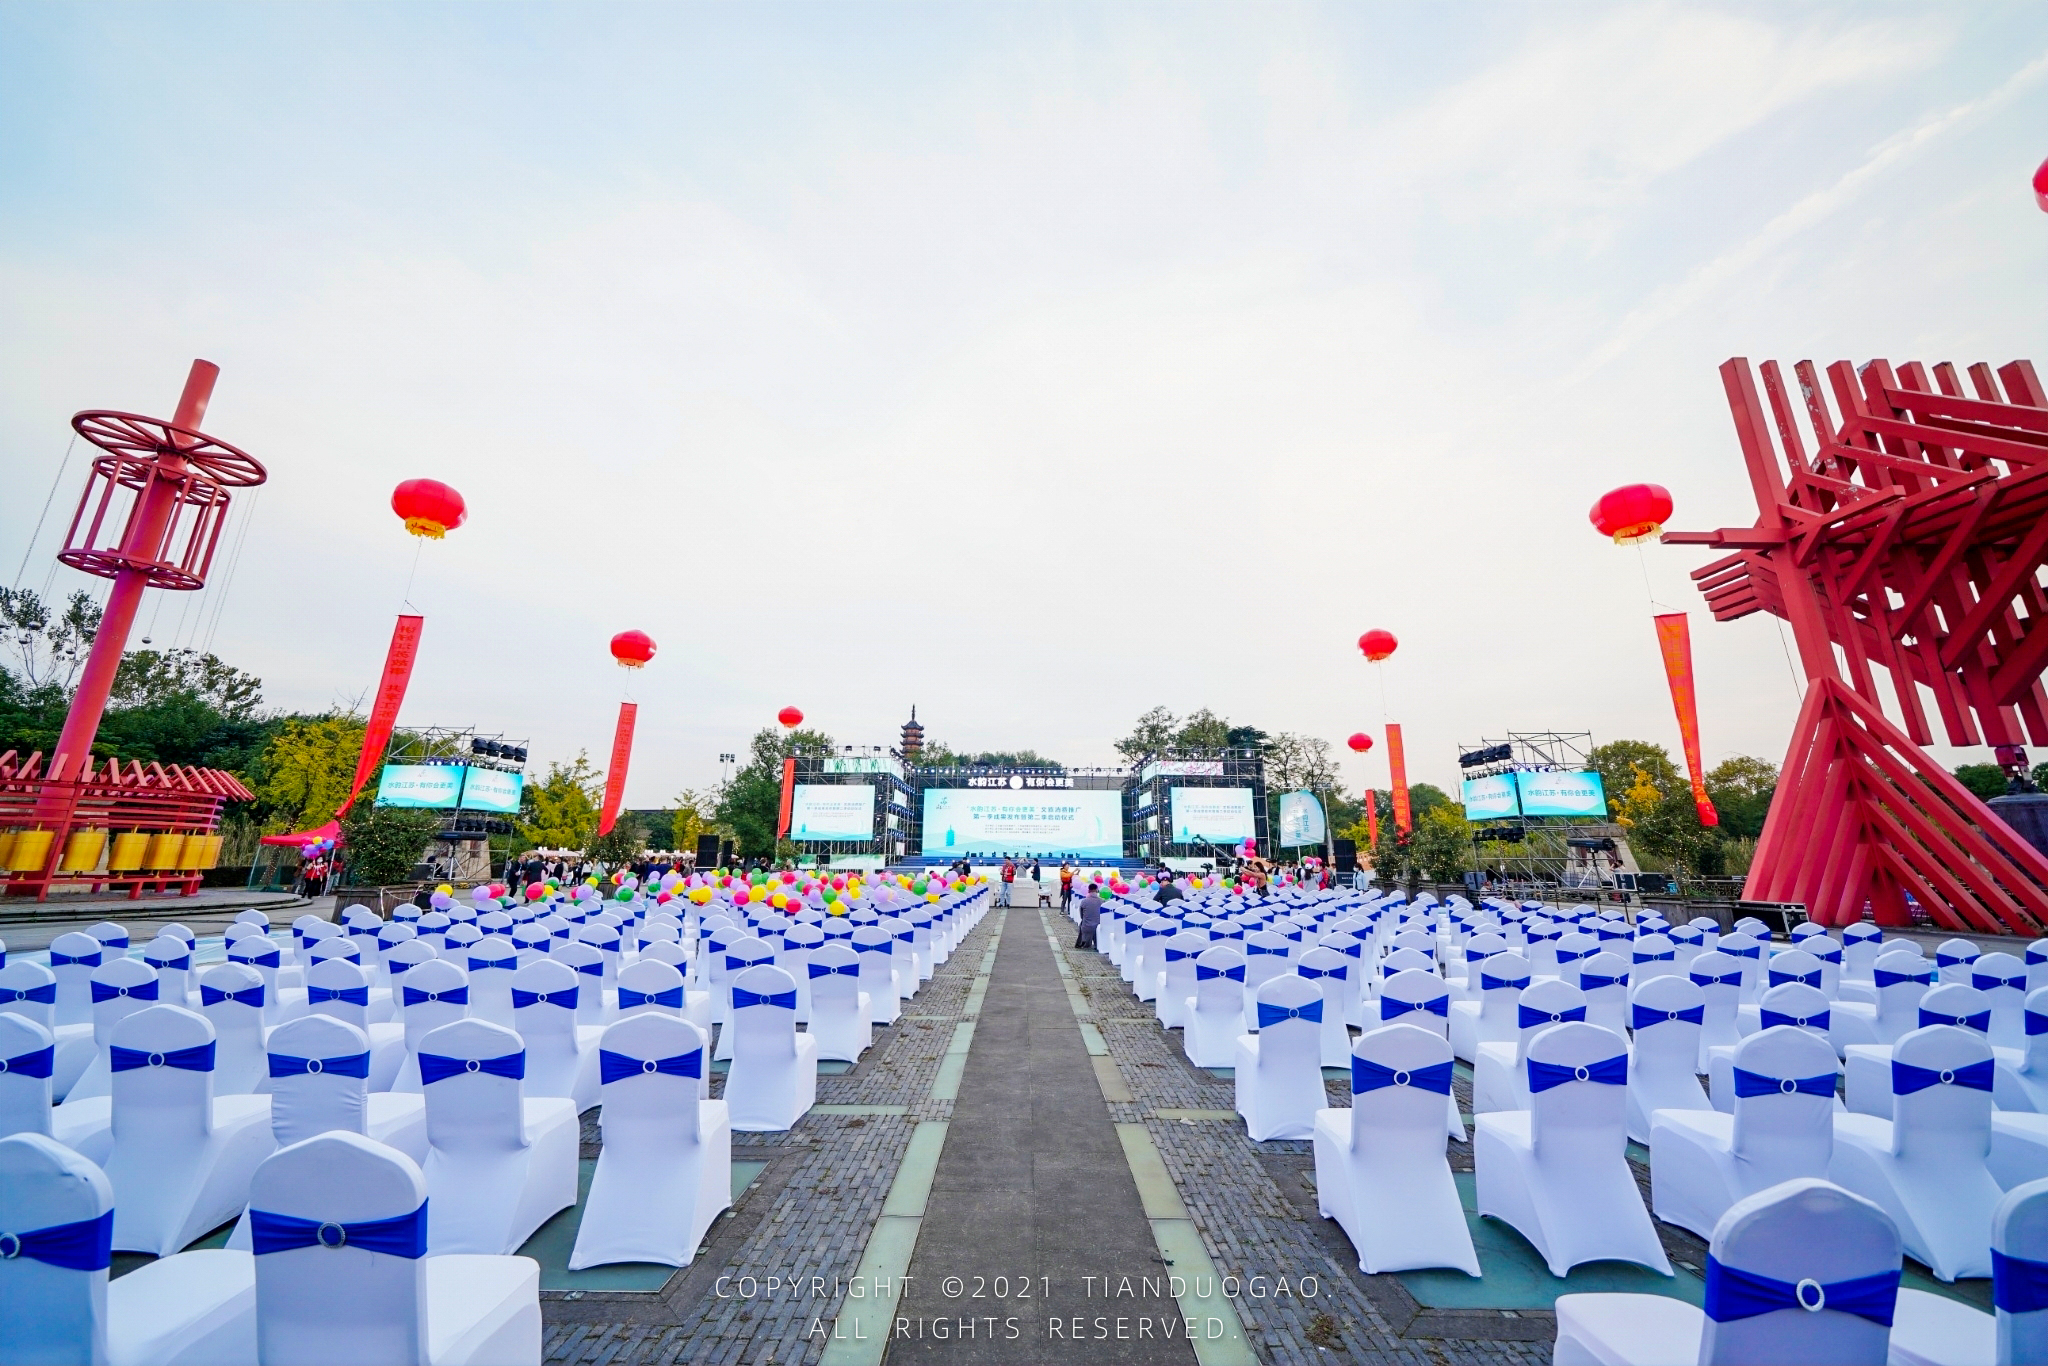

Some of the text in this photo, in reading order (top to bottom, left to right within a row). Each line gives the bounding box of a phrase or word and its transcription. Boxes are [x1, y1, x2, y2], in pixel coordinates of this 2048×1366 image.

[968, 777, 1074, 788] 水韵江苏 有你会更美
